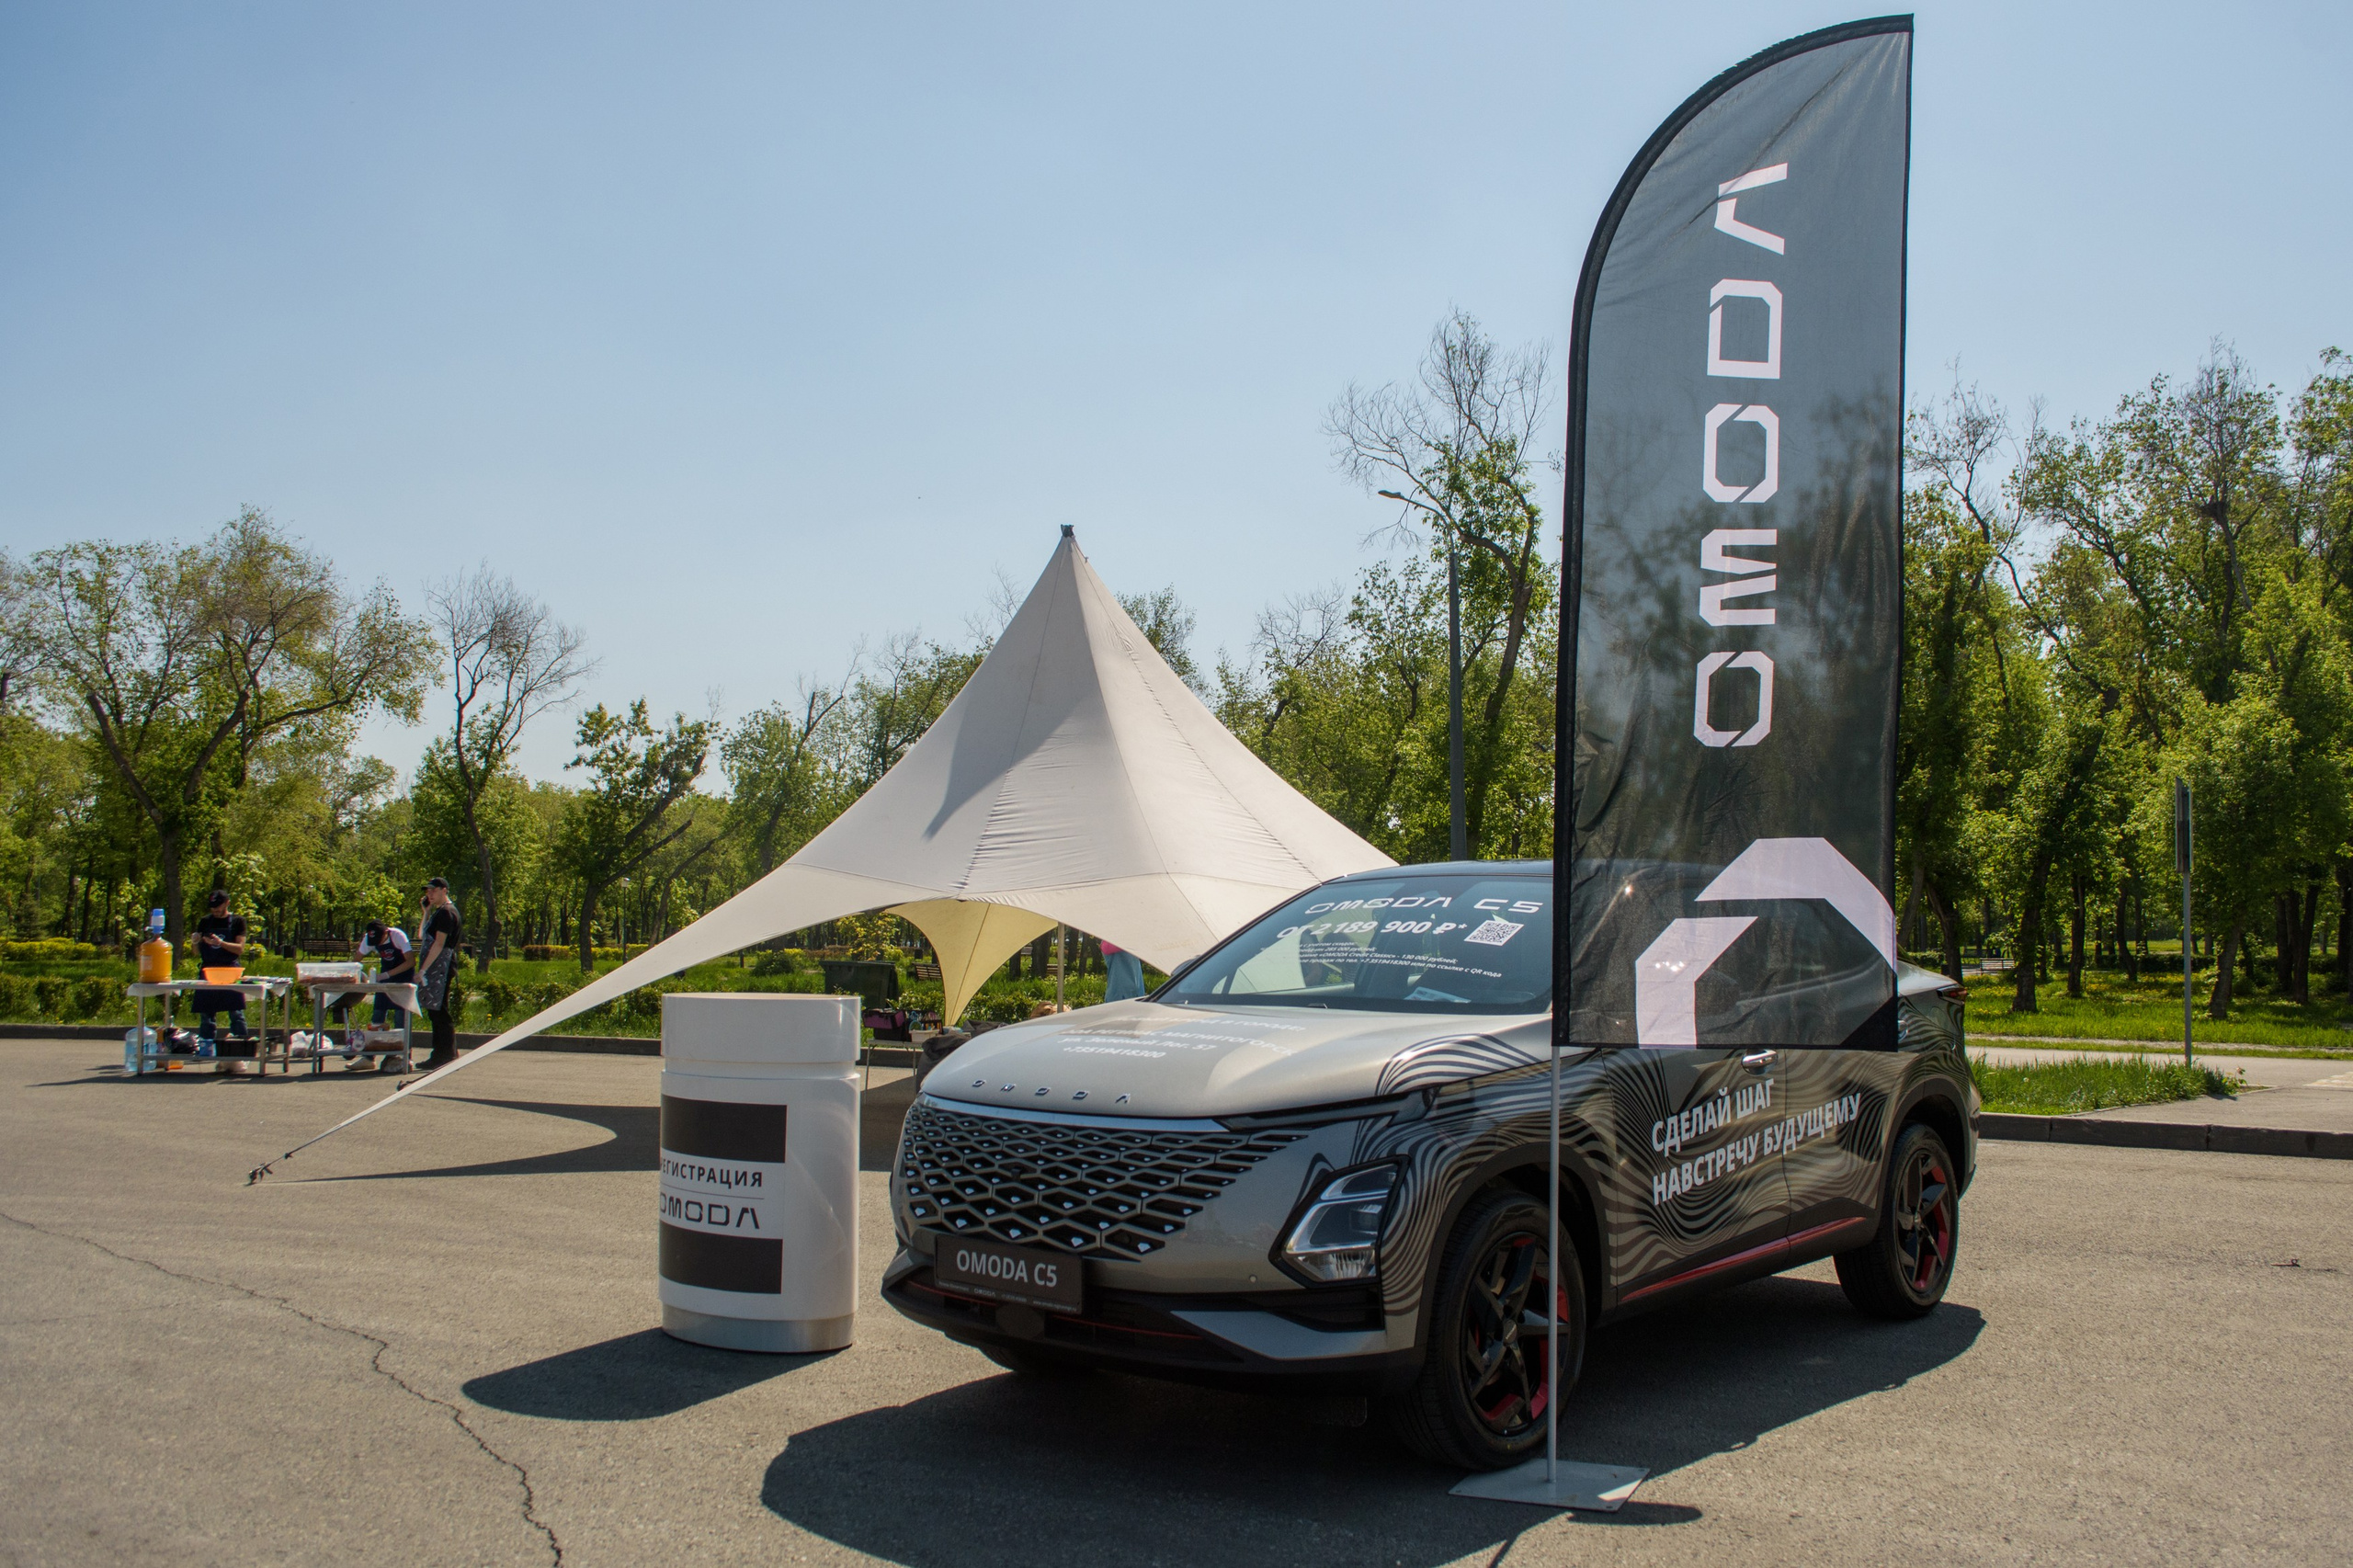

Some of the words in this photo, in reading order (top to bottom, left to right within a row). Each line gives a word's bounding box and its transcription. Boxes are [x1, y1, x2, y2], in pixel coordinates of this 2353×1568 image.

[1693, 162, 1788, 747] OMODA
[1305, 896, 1452, 915] OMODA
[1472, 898, 1544, 914] C5
[1310, 923, 1332, 936] 2
[1333, 921, 1378, 934] 189
[1380, 921, 1431, 934] 900
[1436, 964, 1463, 972] ссылке
[1162, 1030, 1298, 1056] МАГНИТОГОРСК
[1652, 1086, 1732, 1158] СДЕЛАЙ
[1735, 1078, 1775, 1120] ШАГ
[1653, 1131, 1760, 1206] НАВСТРЕЧУ
[1763, 1093, 1861, 1156] БУДУЩЕМУ
[661, 1158, 763, 1189] ЕГИСТРАЦИЯ
[956, 1249, 1029, 1283] OMODA
[1034, 1263, 1058, 1288] C5
